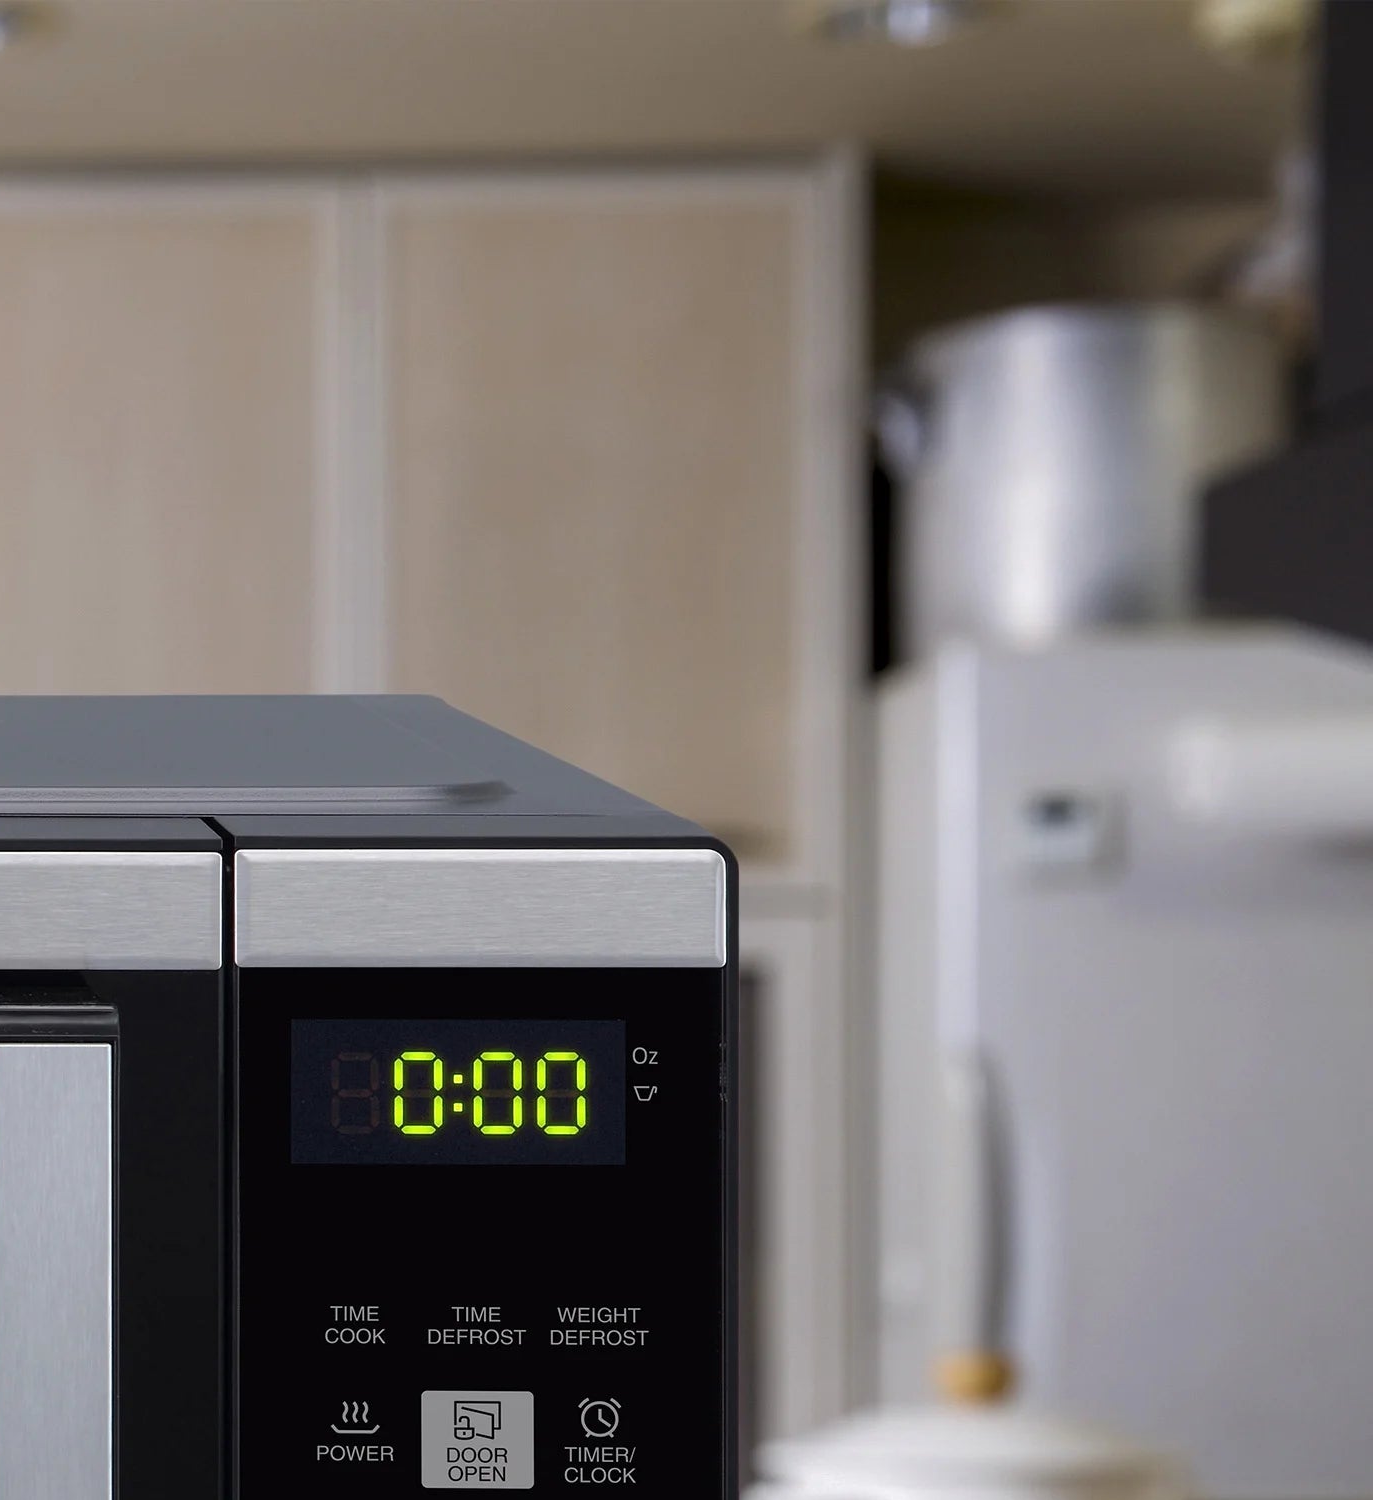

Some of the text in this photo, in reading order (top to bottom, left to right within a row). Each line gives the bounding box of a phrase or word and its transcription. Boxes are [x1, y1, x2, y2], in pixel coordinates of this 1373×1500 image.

[633, 1047, 658, 1064] Oz
[393, 1051, 586, 1135] 0:00
[330, 1306, 379, 1321] TIME
[451, 1307, 500, 1322] TIME
[557, 1307, 641, 1323] WEIGHT
[325, 1328, 385, 1344] COOK
[428, 1329, 526, 1345] DEFROST
[551, 1330, 649, 1345] DEFROST
[317, 1445, 393, 1461] POWER
[447, 1447, 507, 1463] DOOR
[565, 1447, 636, 1462] TIMER/
[448, 1466, 505, 1481] OPEN
[565, 1467, 636, 1483] CLOCK
